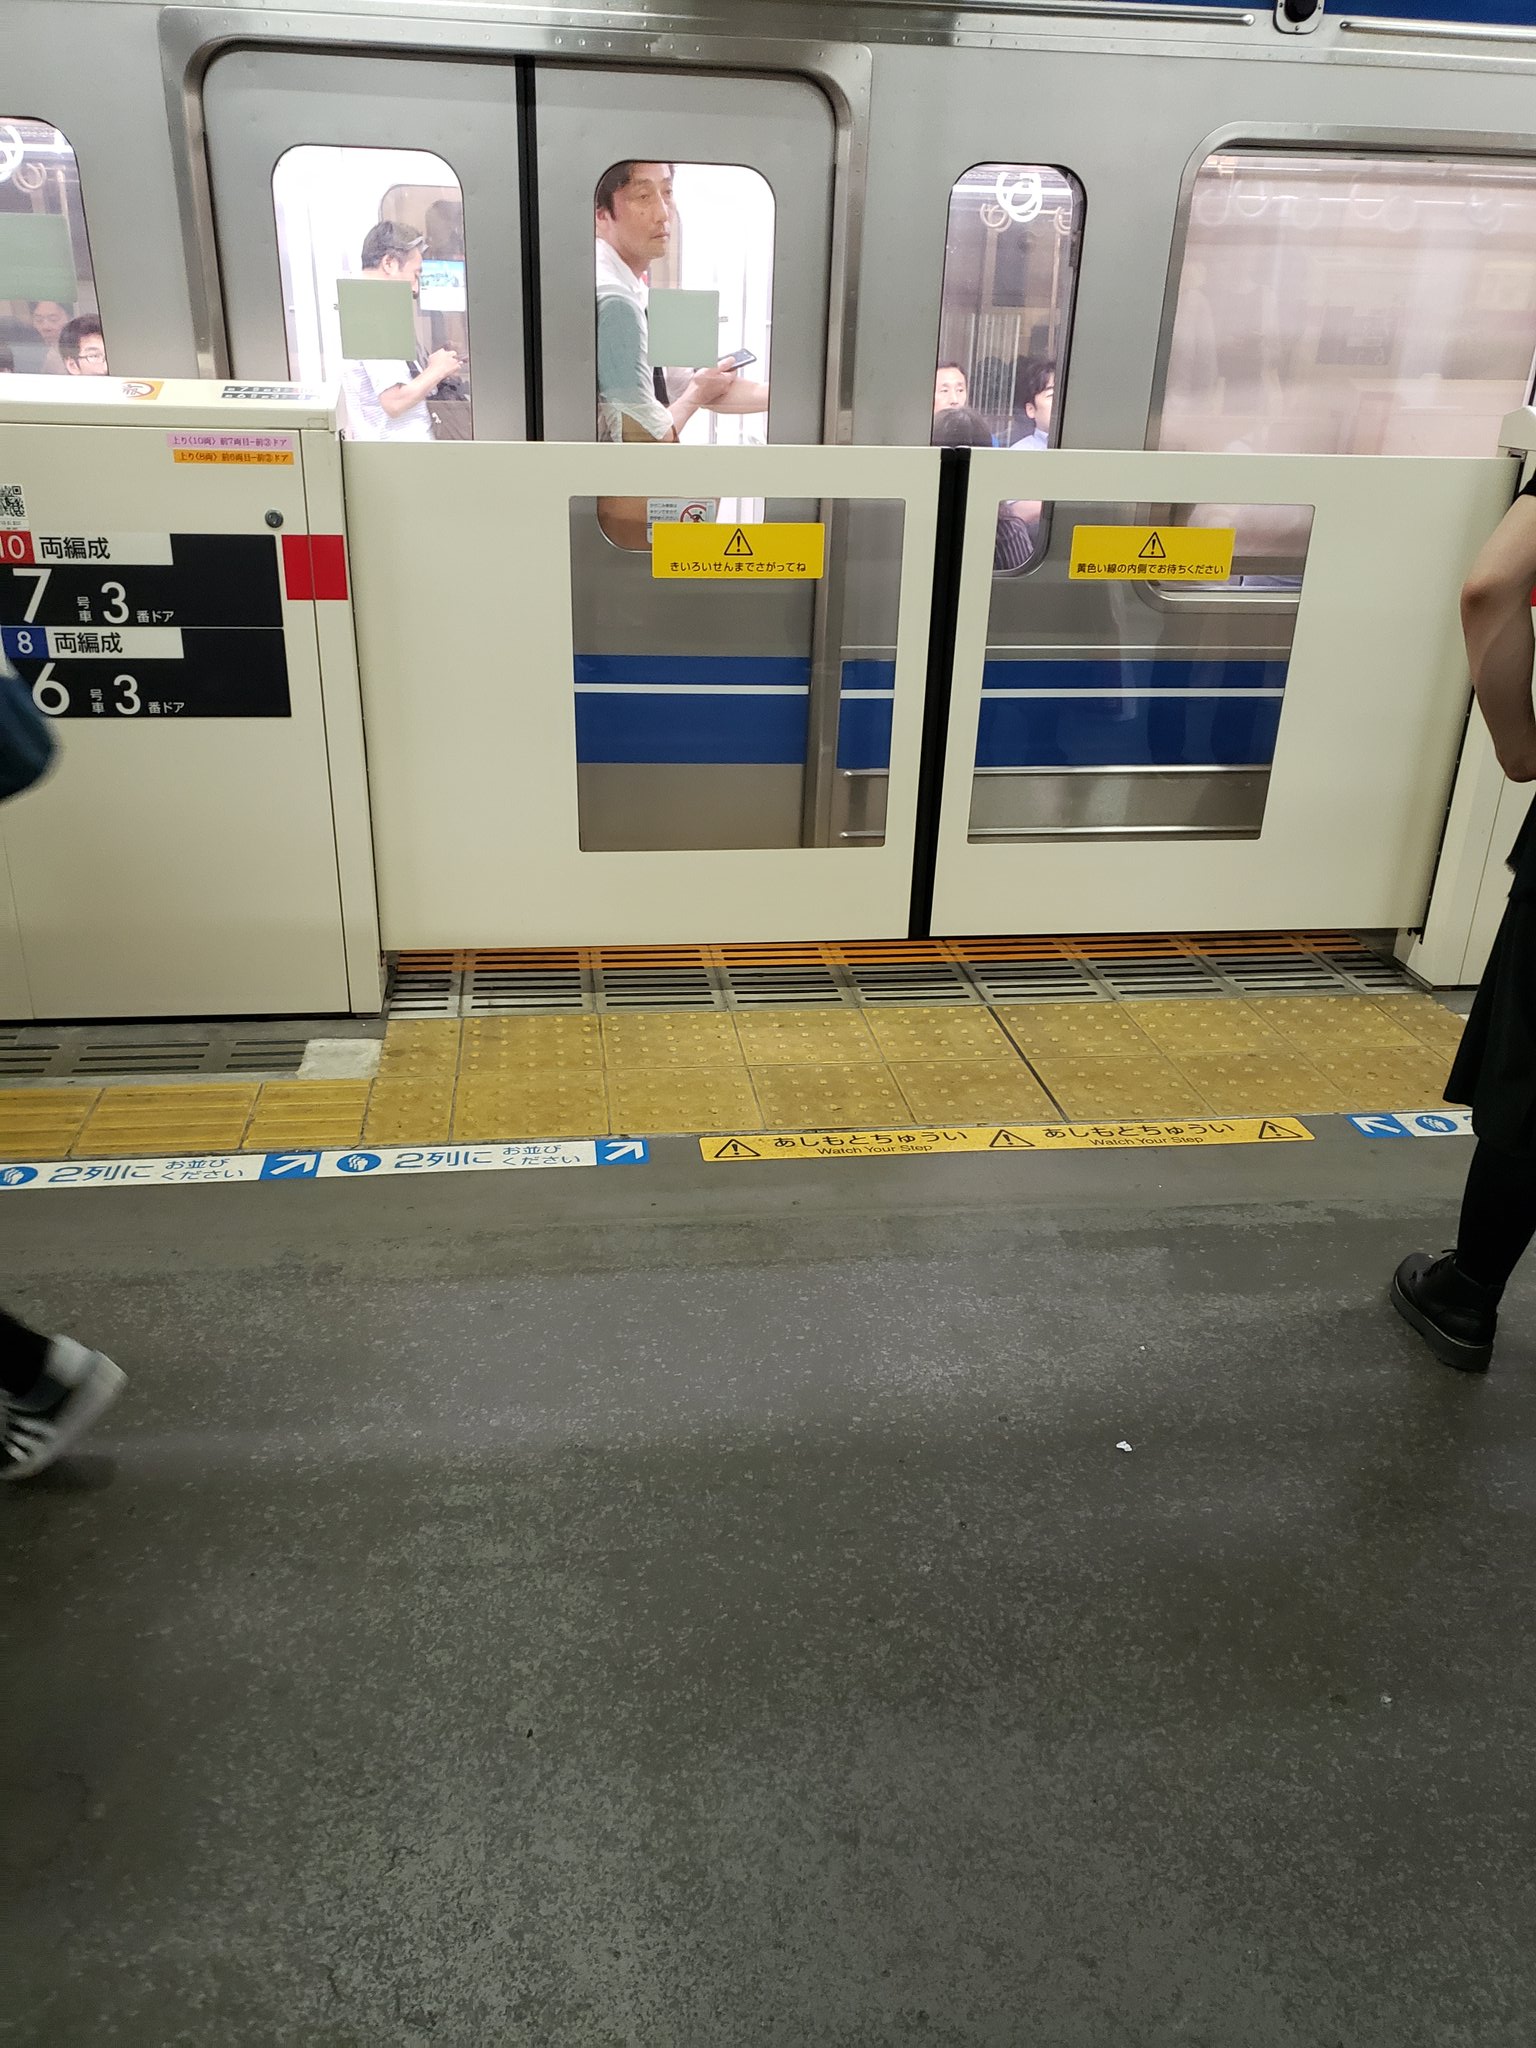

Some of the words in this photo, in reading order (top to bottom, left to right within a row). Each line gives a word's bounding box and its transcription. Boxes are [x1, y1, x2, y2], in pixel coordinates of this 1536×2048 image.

[39, 537, 111, 559] 両編成
[670, 561, 806, 573] きいろいせんまでさがってね
[1077, 563, 1223, 575] 黄色い線の内側でお待ちください
[12, 568, 52, 624] 7
[101, 581, 129, 624] 3
[136, 610, 174, 623] 番ドア
[17, 630, 34, 654] 8
[53, 632, 123, 654] 両編成
[32, 662, 70, 715] 6
[113, 674, 141, 715] 3
[148, 702, 185, 714] 番ドア
[1042, 1123, 1235, 1138] あしもとちゅうい
[774, 1131, 967, 1148] あしもとちゅうい
[1089, 1137, 1135, 1146] Watch
[1137, 1136, 1168, 1145] Your
[1172, 1135, 1203, 1144] Step
[502, 1144, 562, 1155] お並び
[817, 1146, 863, 1156] Watch
[865, 1144, 898, 1154] Your
[901, 1143, 933, 1153] Step
[165, 1158, 231, 1169] お並び
[394, 1150, 492, 1169] 2列に
[502, 1155, 580, 1165] ください
[48, 1164, 154, 1183] 2列に
[161, 1169, 243, 1180] ください
